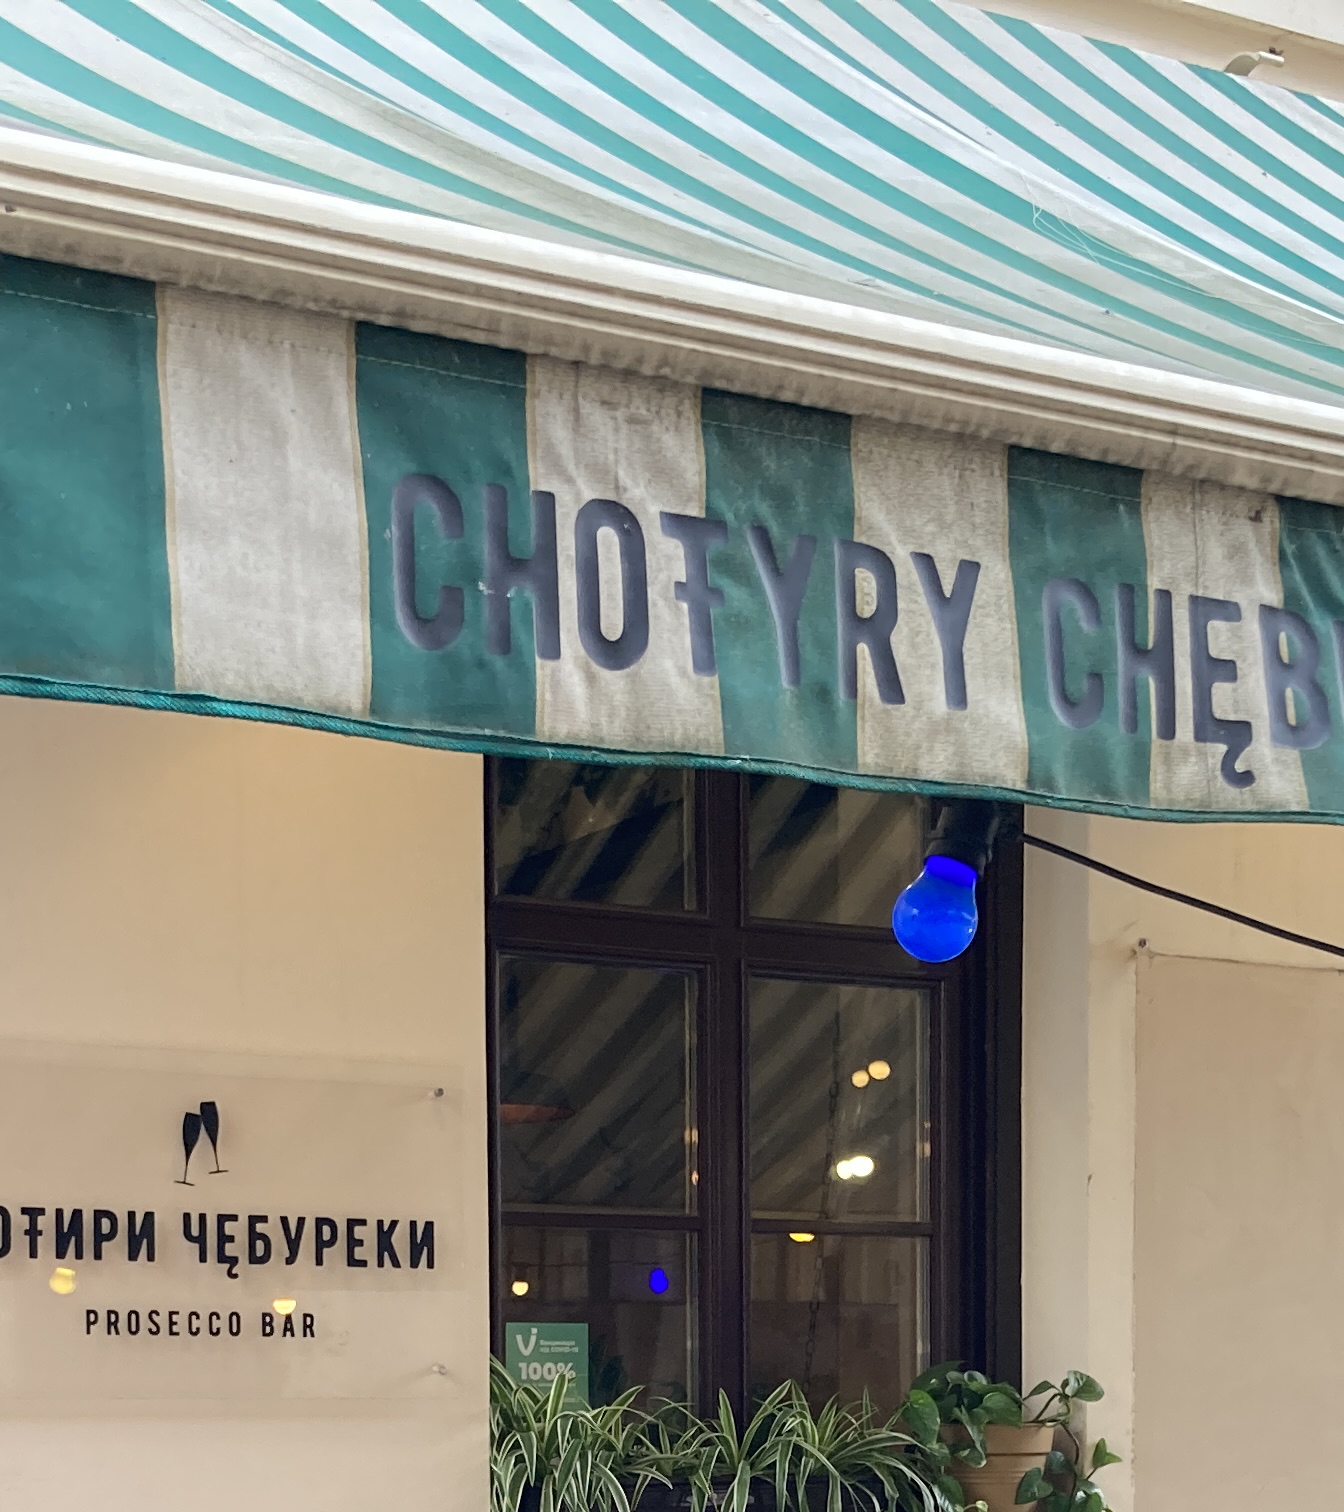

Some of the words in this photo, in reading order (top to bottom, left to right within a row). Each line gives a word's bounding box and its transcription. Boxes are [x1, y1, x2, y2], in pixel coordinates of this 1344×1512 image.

[85, 1308, 242, 1337] PROSECCO
[261, 1312, 316, 1339] BAR
[518, 1362, 577, 1381] 100%
